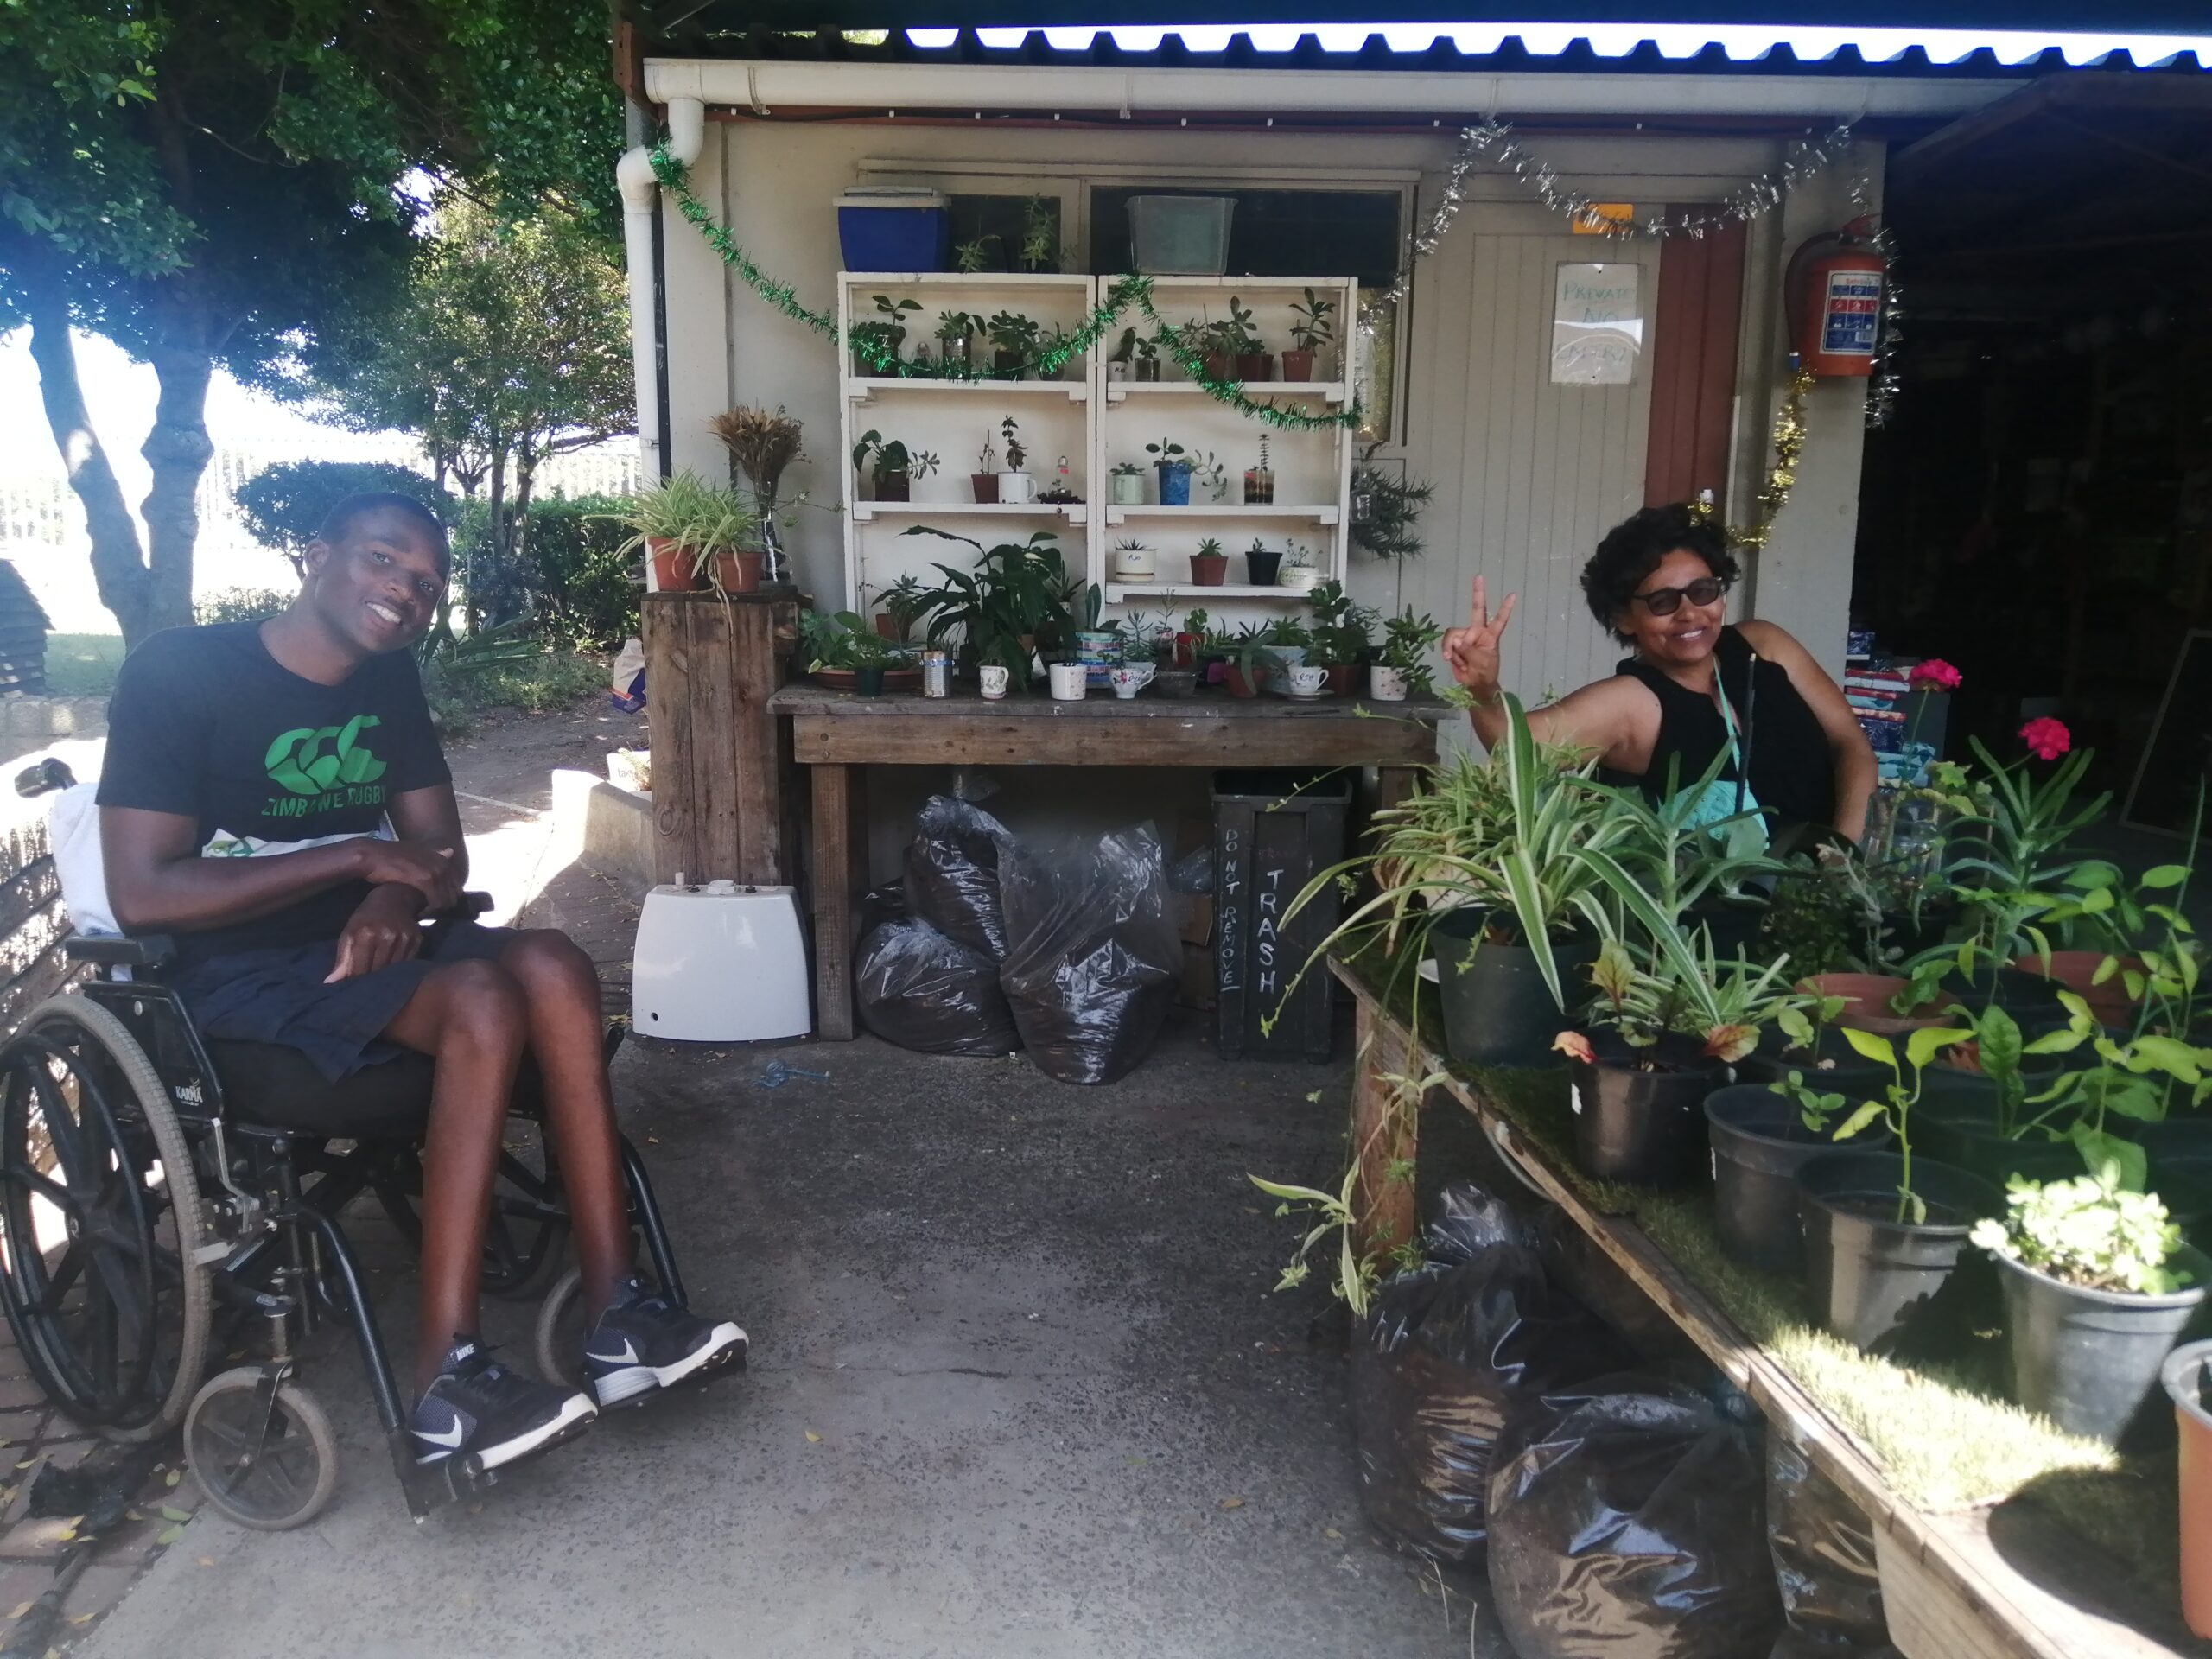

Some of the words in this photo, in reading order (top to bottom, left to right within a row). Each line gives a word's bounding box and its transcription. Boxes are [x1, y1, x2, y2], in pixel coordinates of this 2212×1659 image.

[347, 785, 387, 805] RUGBY
[1225, 830, 1238, 852] DO
[1225, 860, 1240, 895] NOT
[1257, 870, 1284, 993] TRASH
[1223, 907, 1236, 983] REMOVE
[175, 1086, 203, 1103] KARMA
[457, 1344, 474, 1361] NIKE
